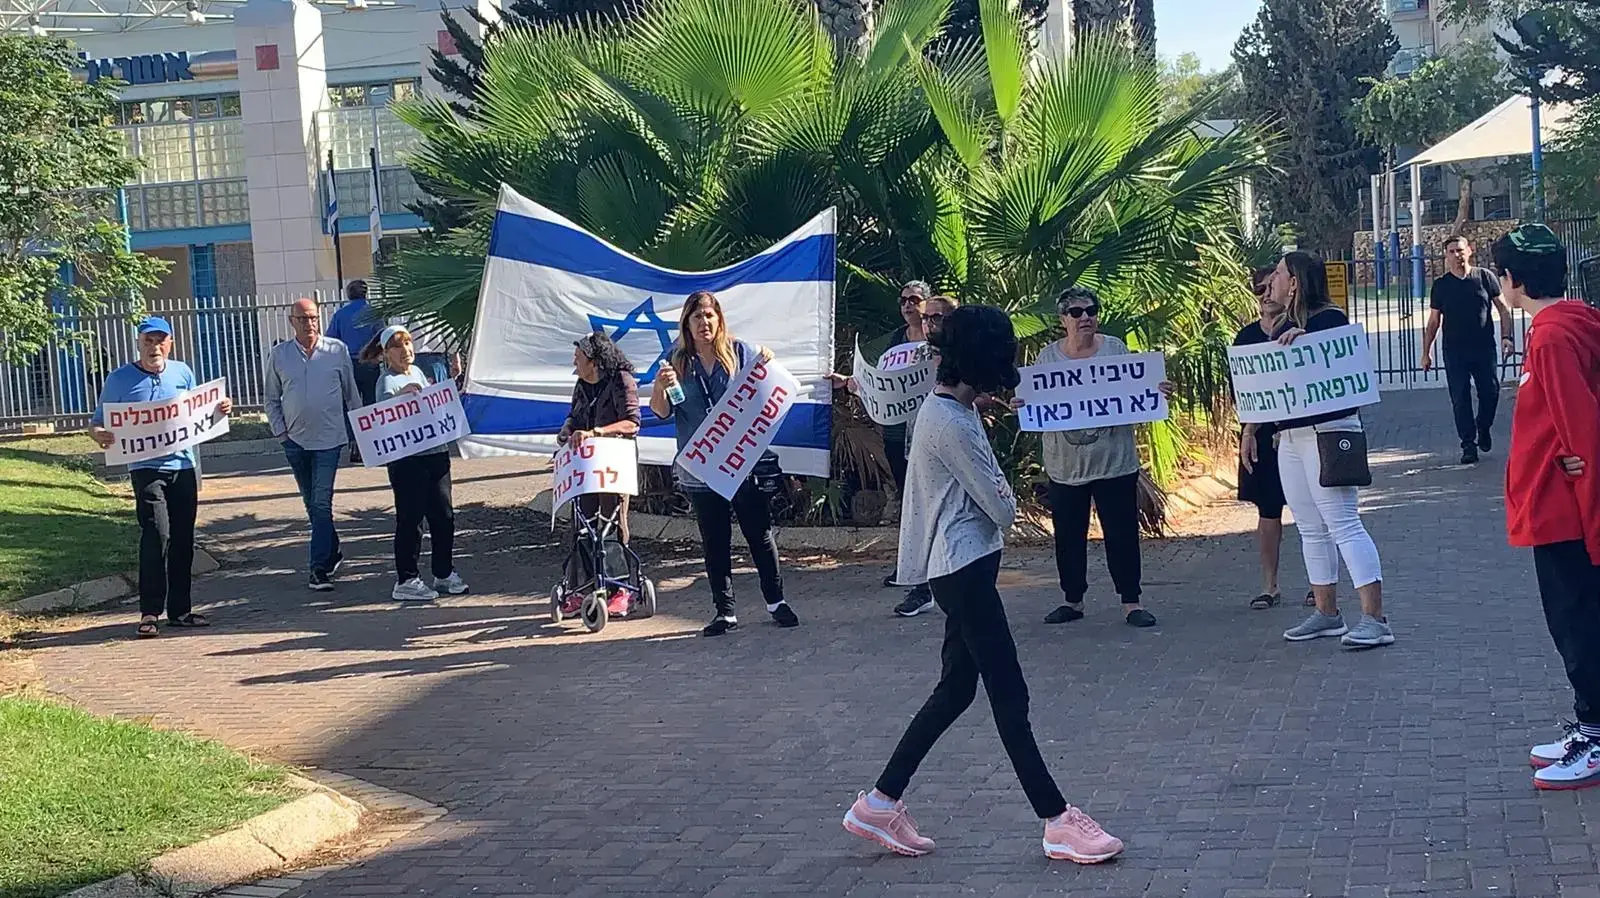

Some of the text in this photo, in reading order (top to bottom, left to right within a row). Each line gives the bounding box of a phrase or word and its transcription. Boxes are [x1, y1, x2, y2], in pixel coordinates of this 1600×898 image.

[1230, 335, 1359, 375] יועץ רב המרצחים
[876, 376, 895, 391] רב
[898, 367, 929, 393] יועץ
[1032, 362, 1145, 391] טיבי! אתה
[1304, 372, 1369, 408] ערפאת,
[110, 387, 219, 428] תומך מחבלים
[358, 388, 454, 431] תומך מחבלים
[685, 361, 768, 465] טיבי! מהלל
[884, 393, 929, 419] רפאת,
[1026, 388, 1159, 428] לא רצוי כאן!
[1278, 382, 1296, 414] לך
[120, 413, 214, 454] לא בעירנו!
[373, 413, 456, 456] לא בעירנו!
[719, 386, 789, 478] השהידים!
[593, 466, 618, 488] לך
